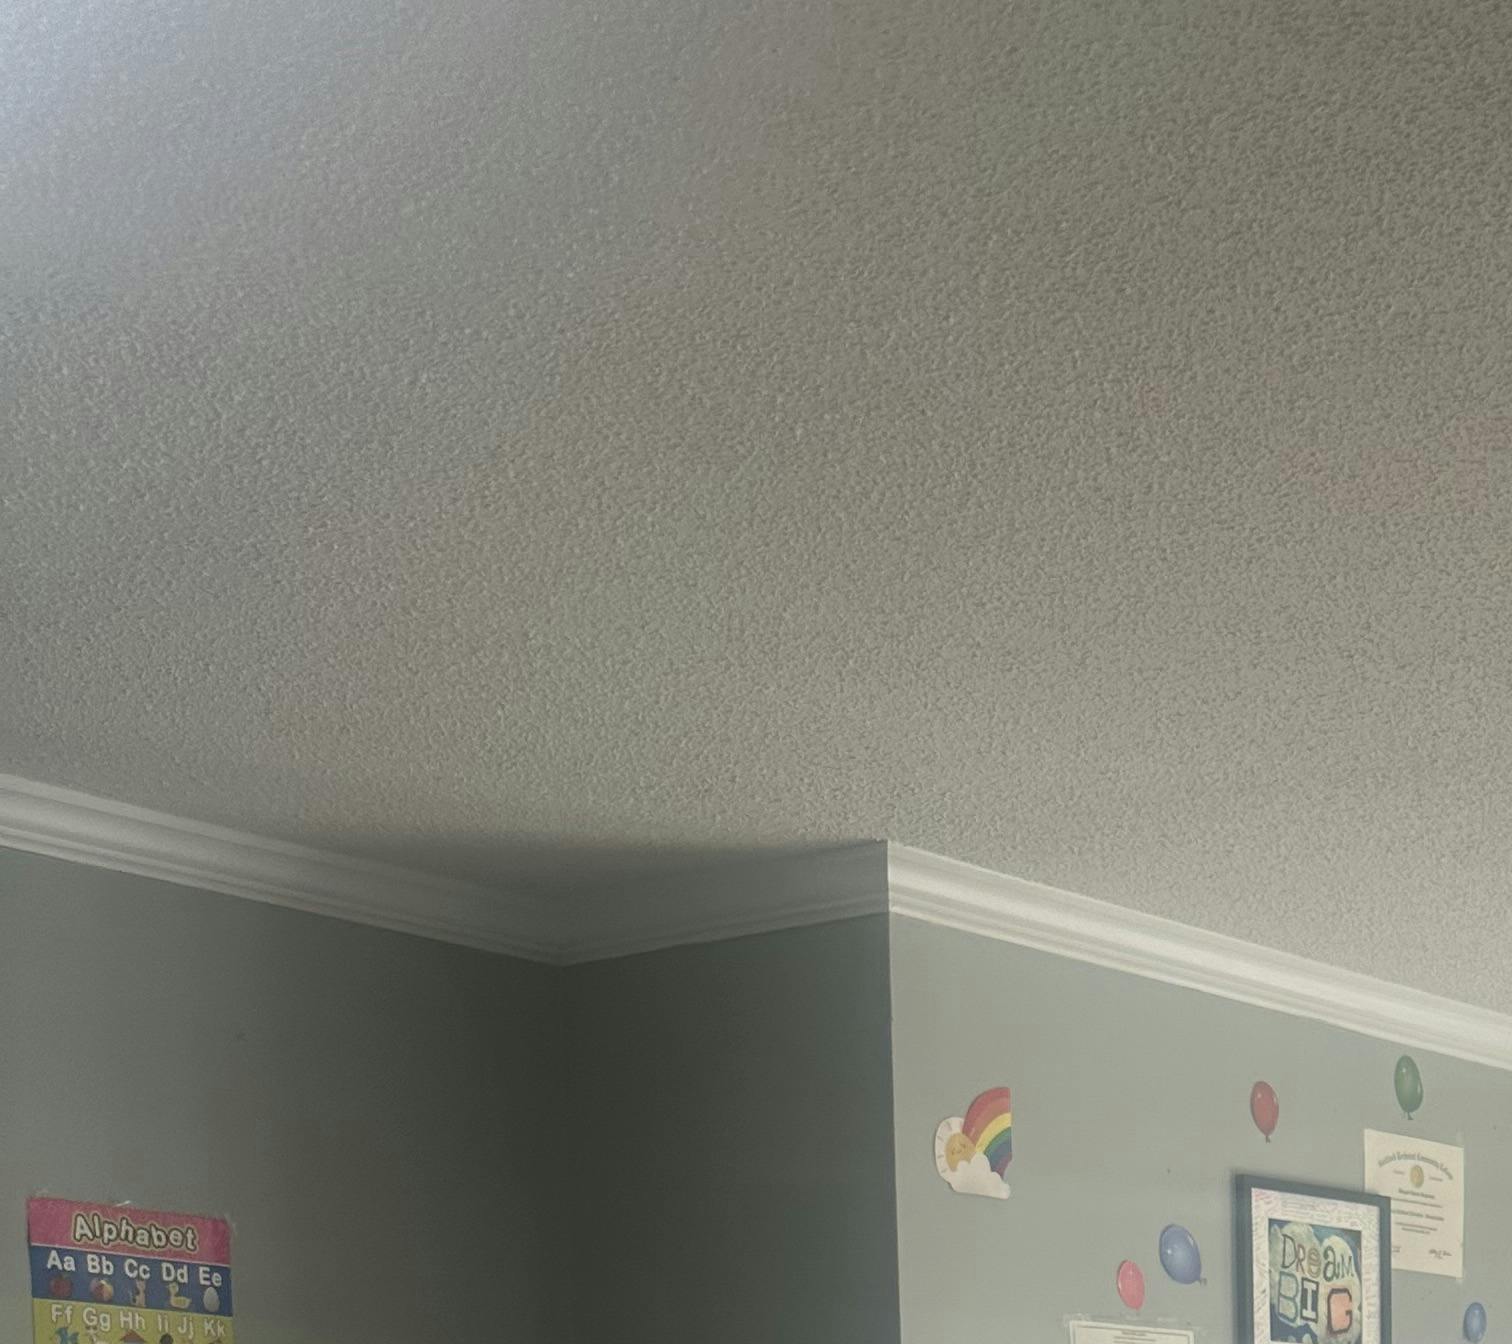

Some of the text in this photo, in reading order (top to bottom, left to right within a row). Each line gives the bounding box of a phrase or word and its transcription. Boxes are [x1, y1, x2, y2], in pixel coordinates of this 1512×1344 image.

[74, 1213, 198, 1250] Alphabet
[46, 1250, 223, 1287] Aa Bb Cc Dd Ee
[1279, 1270, 1352, 1334] BIG
[51, 1304, 225, 1339] Ff Gg Hh Ii Jj Kk
